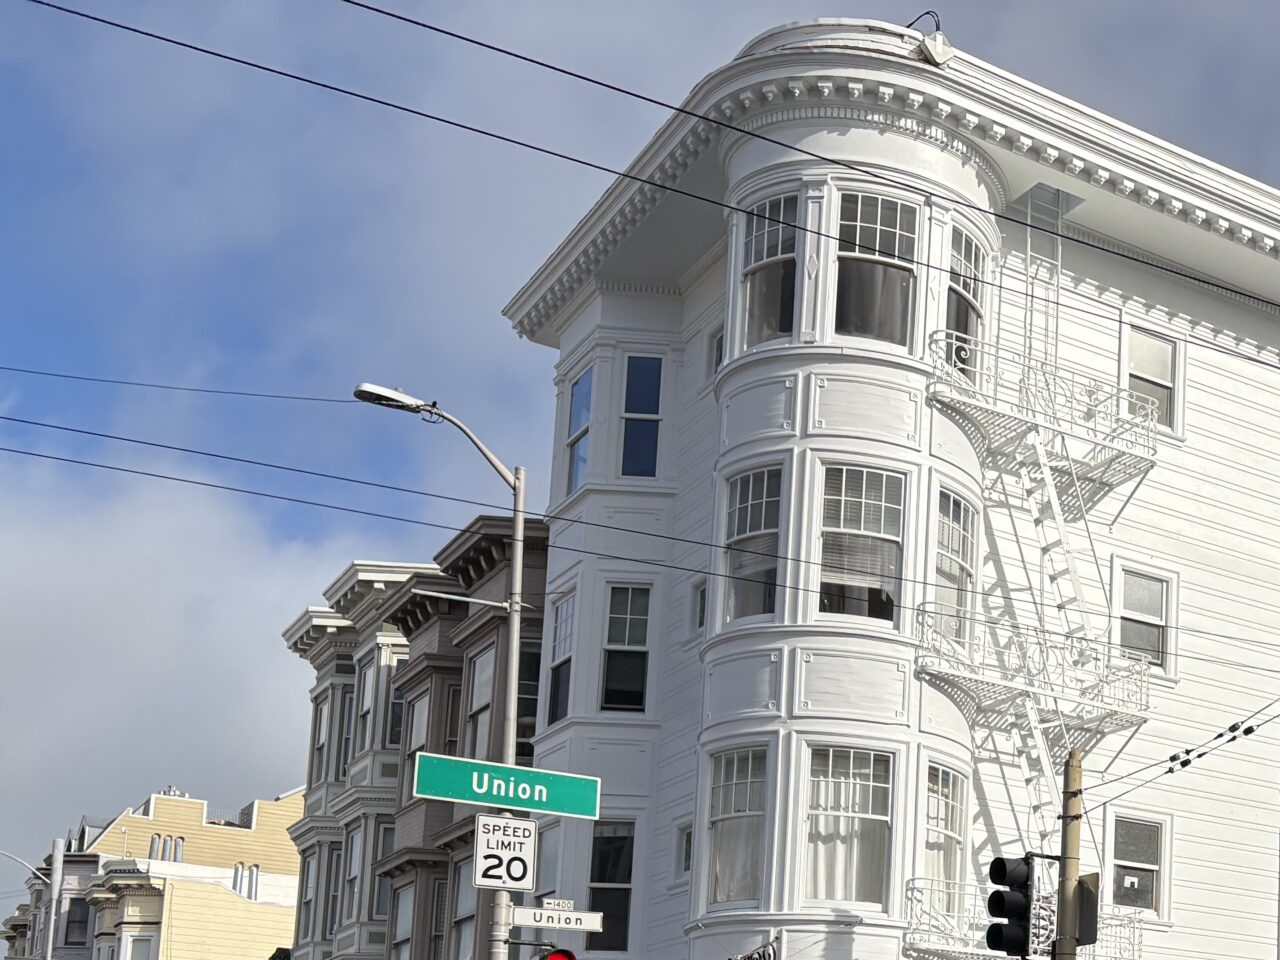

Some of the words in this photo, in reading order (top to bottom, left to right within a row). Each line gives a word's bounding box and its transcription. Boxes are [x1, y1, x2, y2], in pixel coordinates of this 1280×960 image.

[472, 771, 548, 802] Union
[482, 823, 532, 839] SPEED
[486, 838, 525, 853] LIMIT
[481, 854, 528, 882] 20
[533, 911, 583, 926] Union
